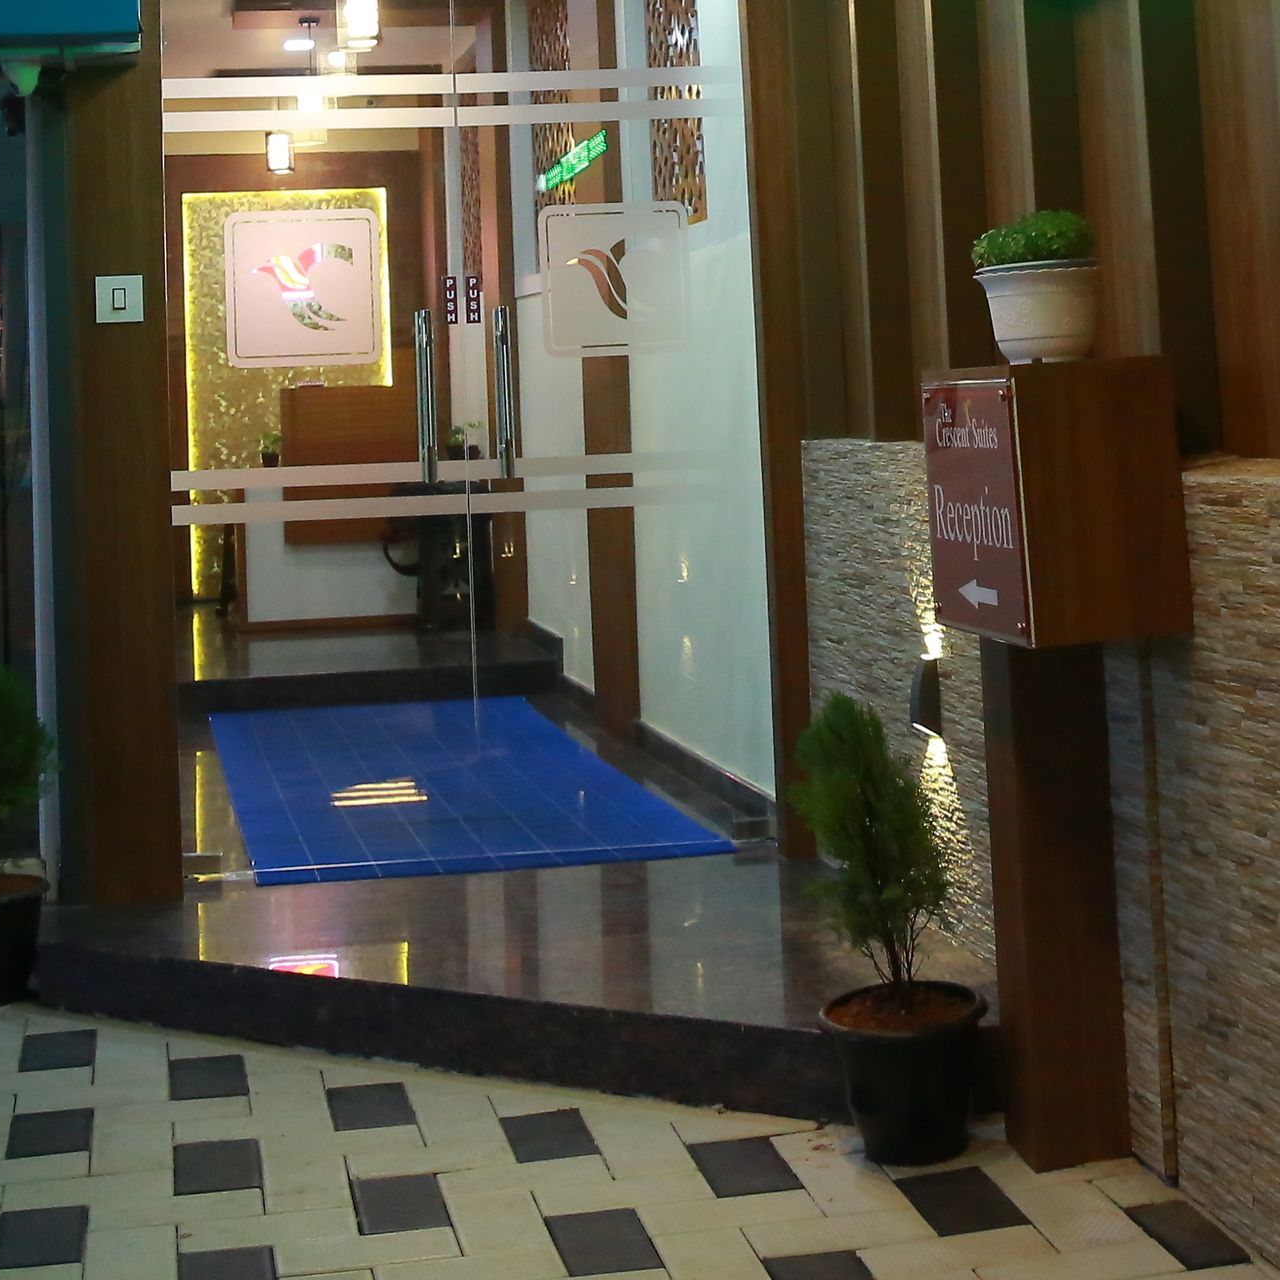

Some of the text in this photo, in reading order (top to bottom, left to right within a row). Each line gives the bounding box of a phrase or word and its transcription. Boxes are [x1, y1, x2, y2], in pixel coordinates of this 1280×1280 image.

[446, 278, 456, 322] PUSH
[469, 277, 479, 322] PUSH
[936, 418, 999, 449] Crescent Suites
[933, 484, 1014, 561] Reception
